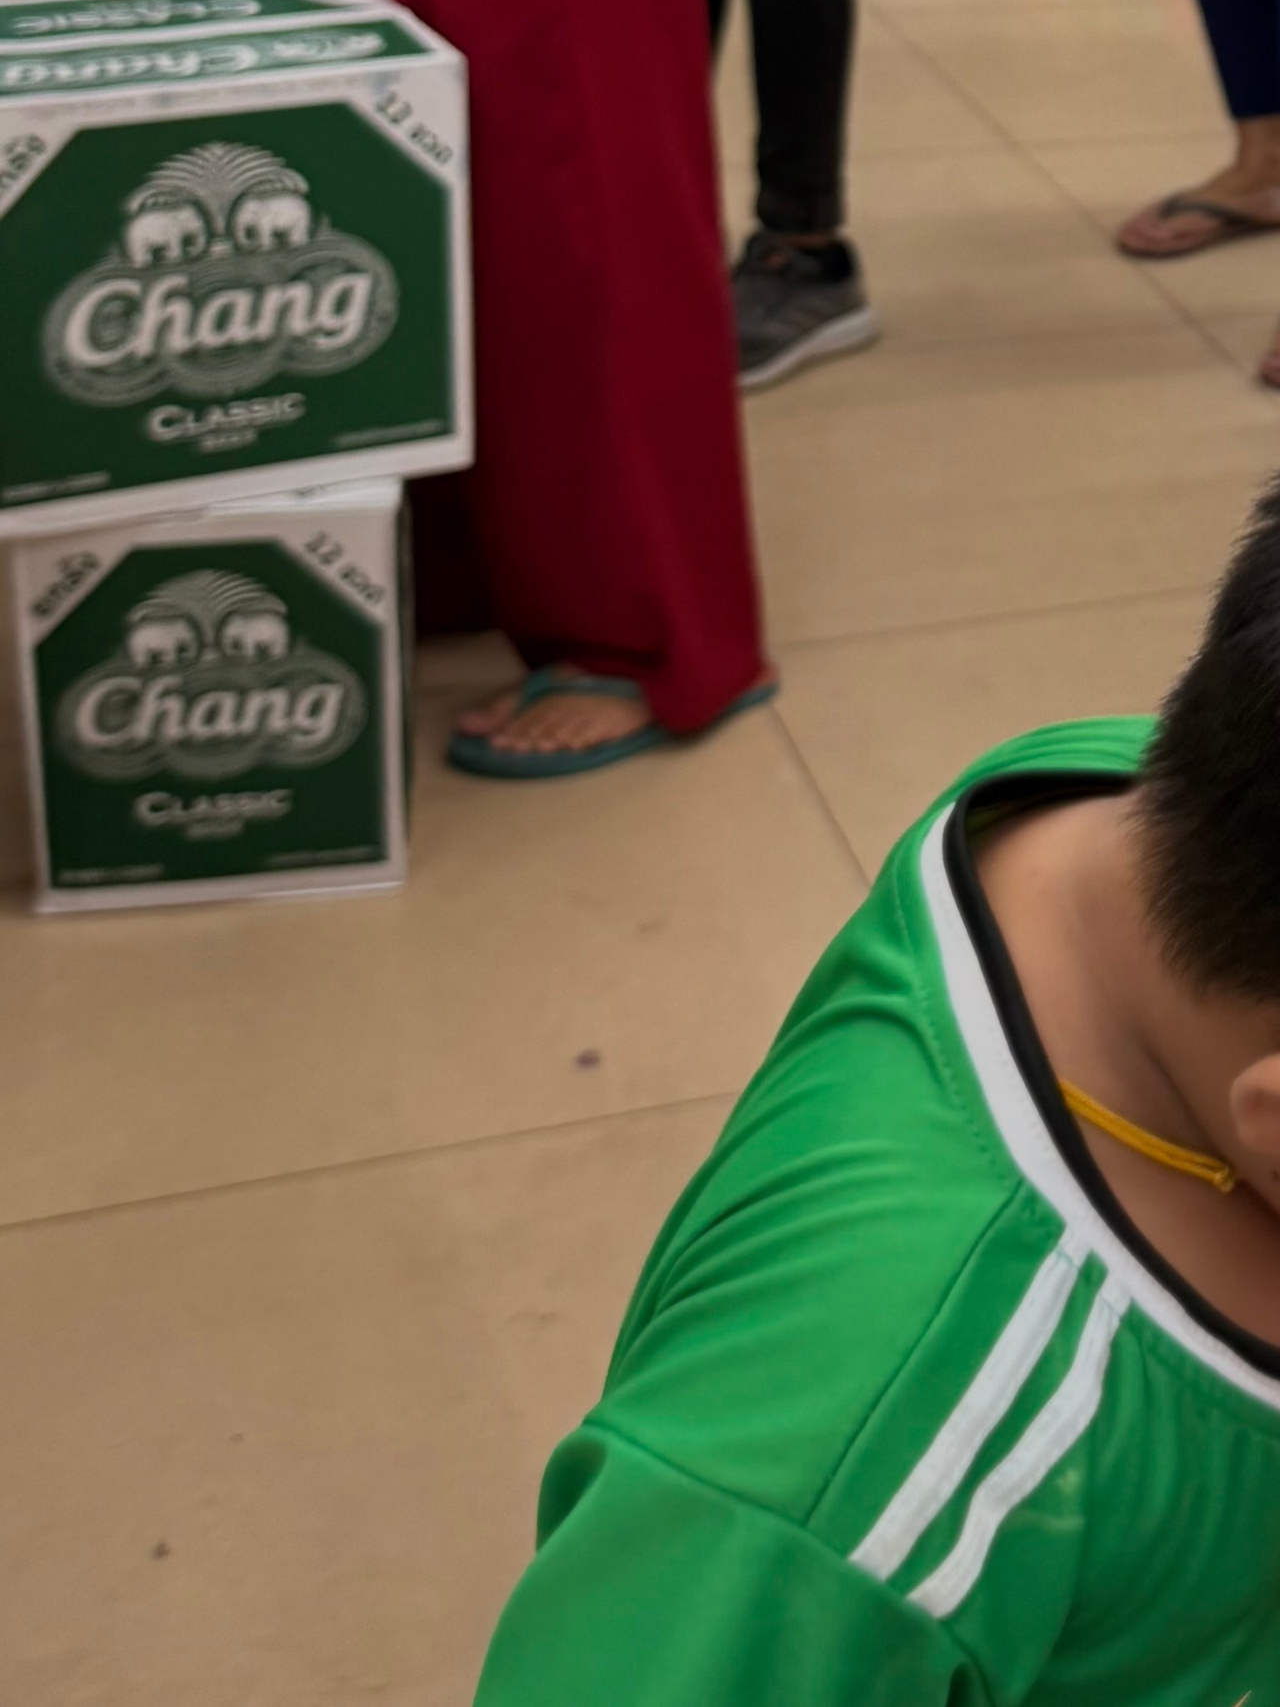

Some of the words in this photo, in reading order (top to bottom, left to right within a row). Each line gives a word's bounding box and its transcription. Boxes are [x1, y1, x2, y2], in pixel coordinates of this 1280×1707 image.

[64, 272, 373, 368] Chang
[143, 393, 307, 439] CLASSIC
[74, 676, 346, 747] Chang
[134, 788, 293, 827] CLASSIC
